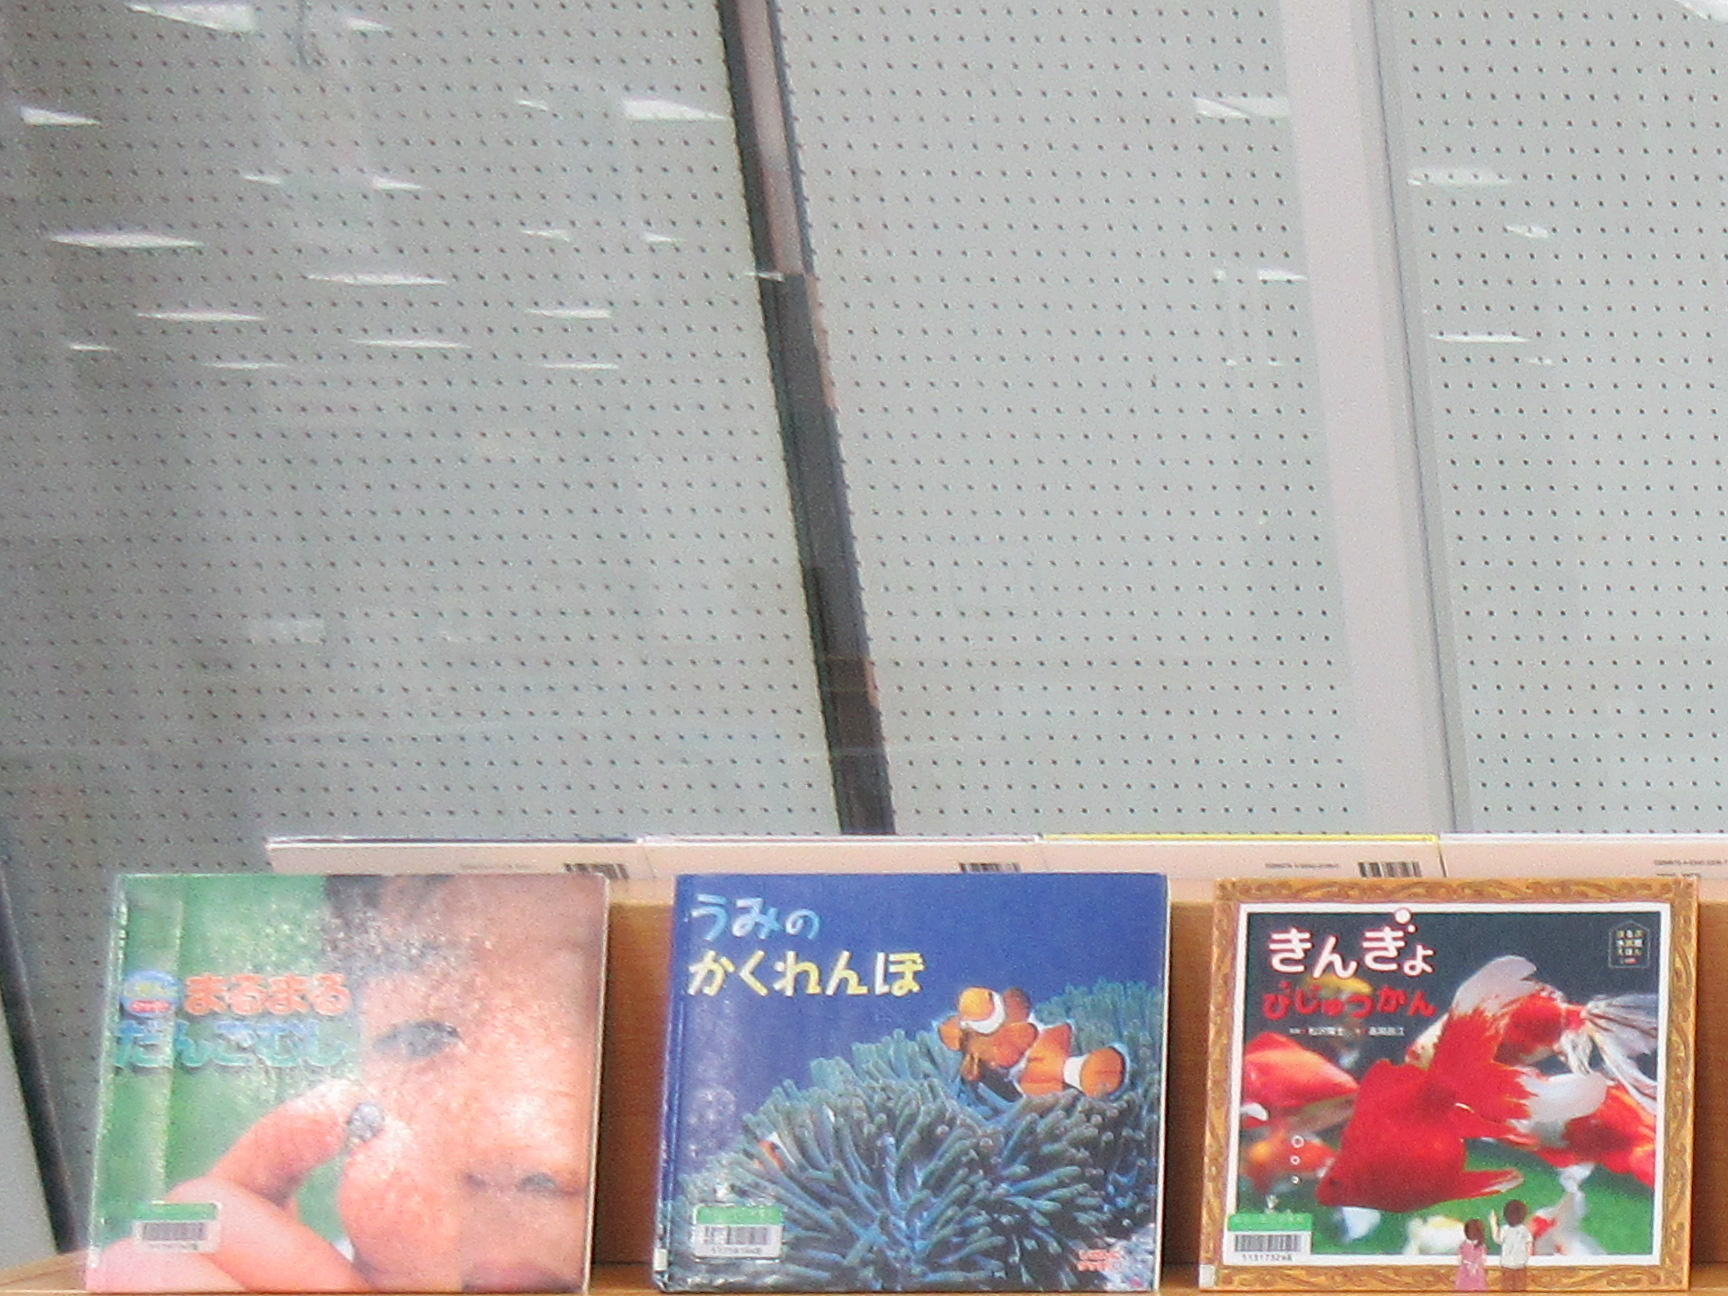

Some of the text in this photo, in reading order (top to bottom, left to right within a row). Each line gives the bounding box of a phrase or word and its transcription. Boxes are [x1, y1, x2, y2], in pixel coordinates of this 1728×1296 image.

[689, 894, 820, 941] うみの
[1267, 908, 1437, 980] きんぎょ
[184, 972, 351, 1016] まるまる
[686, 950, 926, 997] かくれんぼ
[1262, 981, 1438, 1020] びじゅつかん
